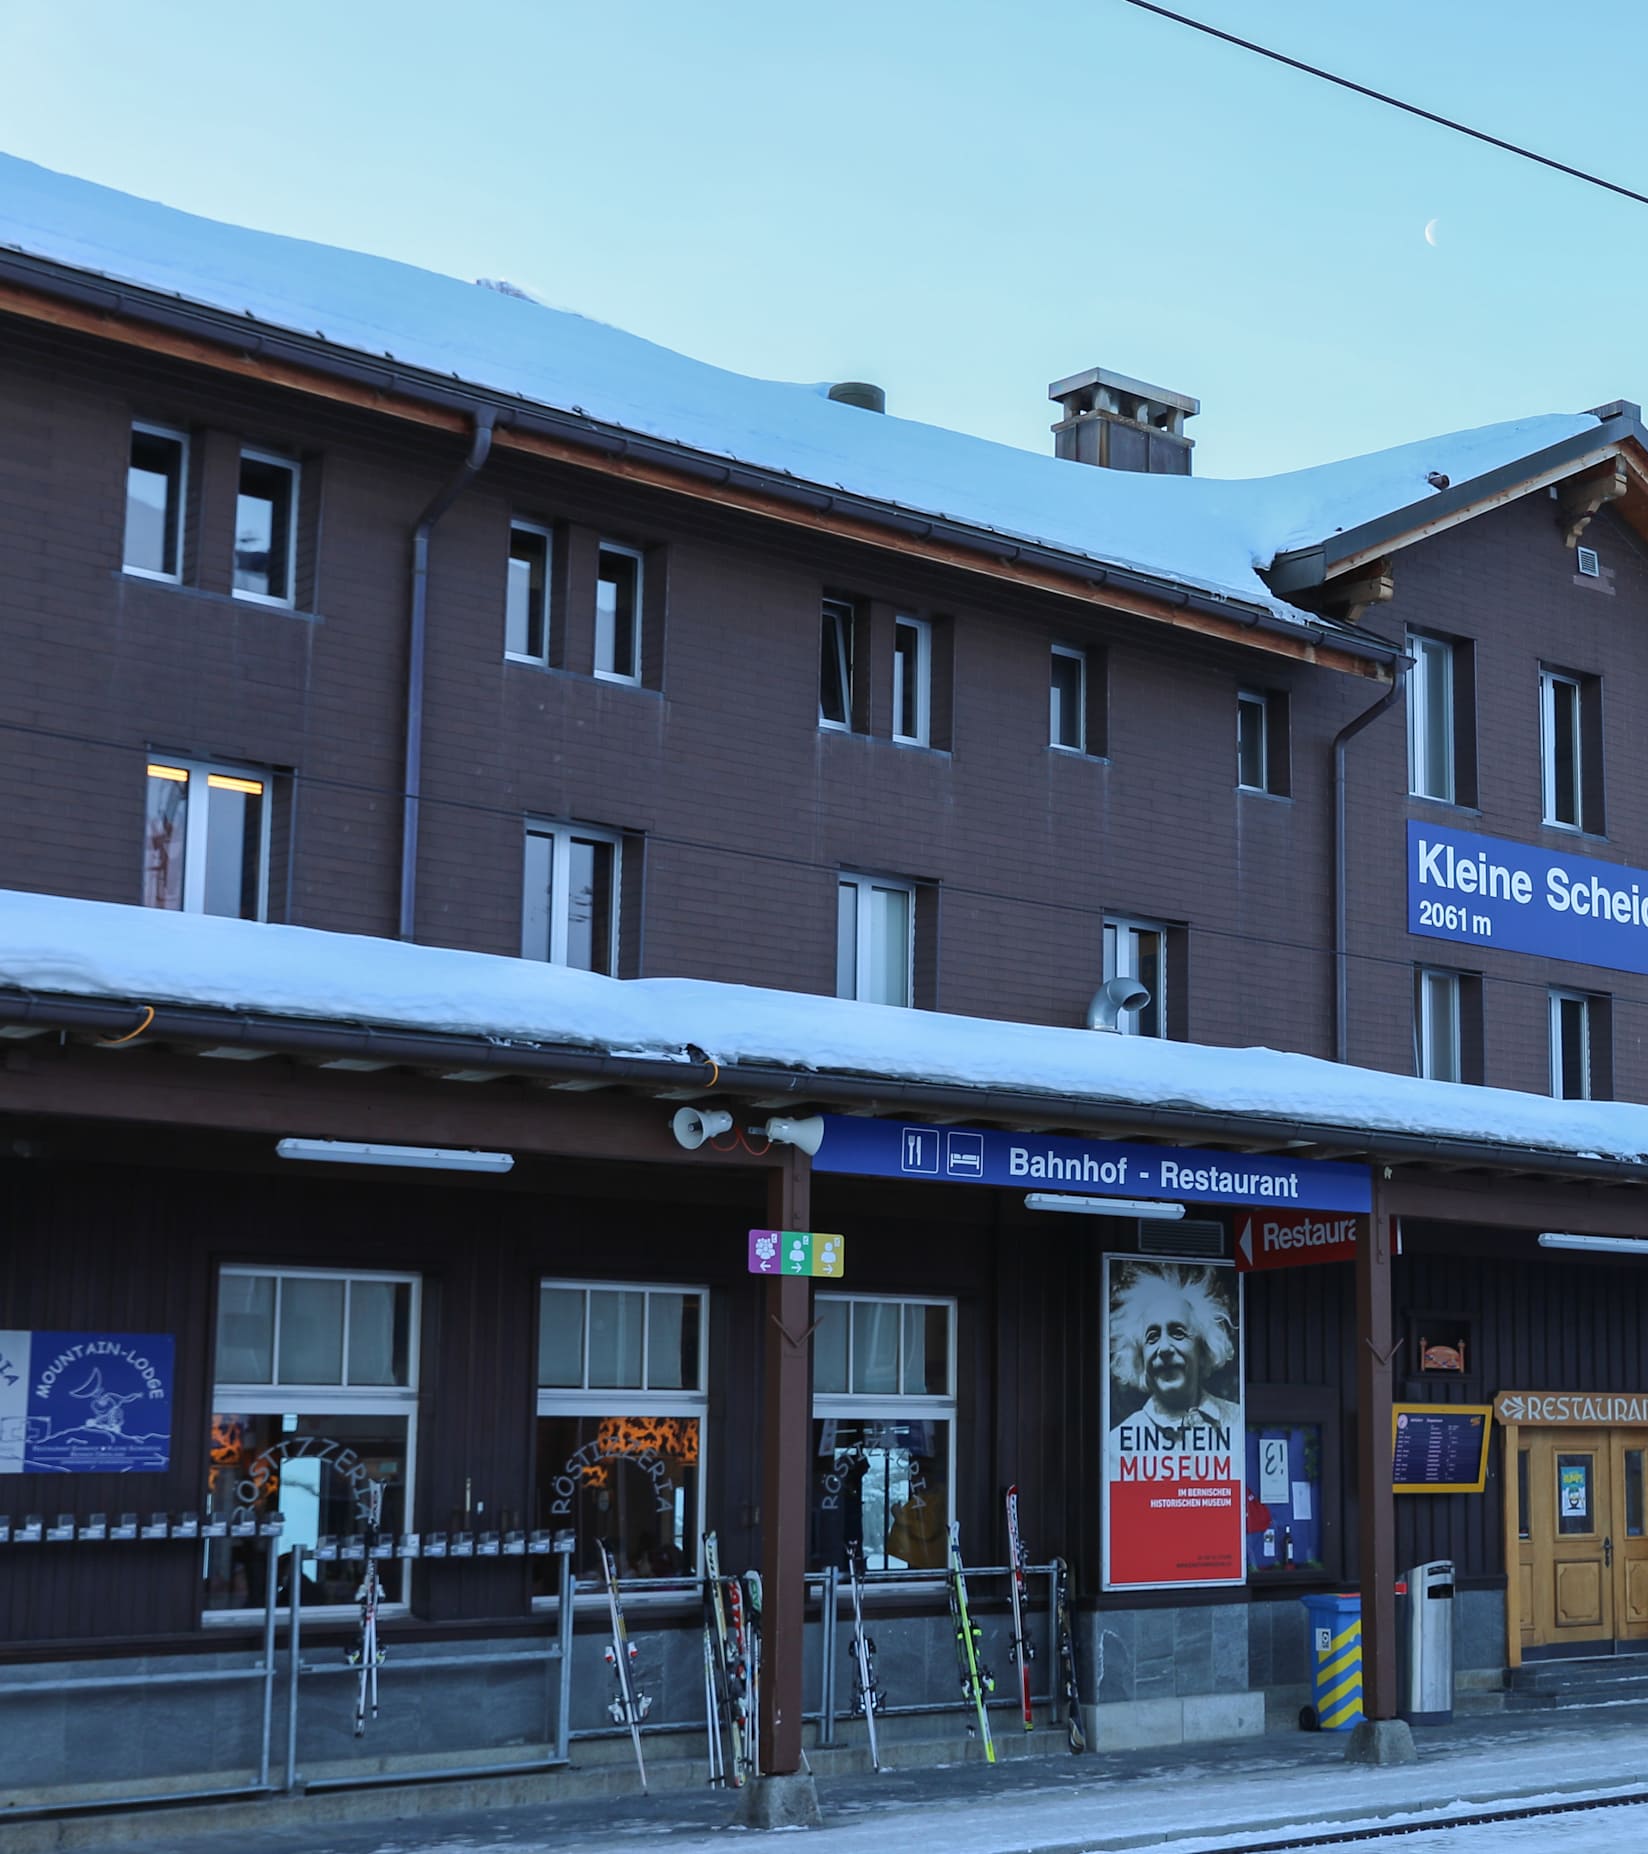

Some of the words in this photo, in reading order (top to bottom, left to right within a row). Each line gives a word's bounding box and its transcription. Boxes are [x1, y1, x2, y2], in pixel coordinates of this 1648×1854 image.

[1418, 839, 1533, 904] Kleine
[1419, 900, 1467, 932] 2061
[1472, 914, 1492, 936] m
[1009, 1147, 1128, 1185] Bahnhof
[1160, 1161, 1299, 1199] Restaurant
[1263, 1217, 1356, 1252] Restaura
[35, 1341, 164, 1399] MOUNTAIN-LODGE
[1120, 1426, 1231, 1451] EINSTEIN
[551, 1436, 673, 1514] RÖSTIZZERIA
[1120, 1456, 1231, 1481] MUSEUM
[1150, 1498, 1201, 1508] HISTORISCHEN
[1202, 1497, 1232, 1507] MUSEUM
[1188, 1487, 1232, 1497] BERNISCHEN
